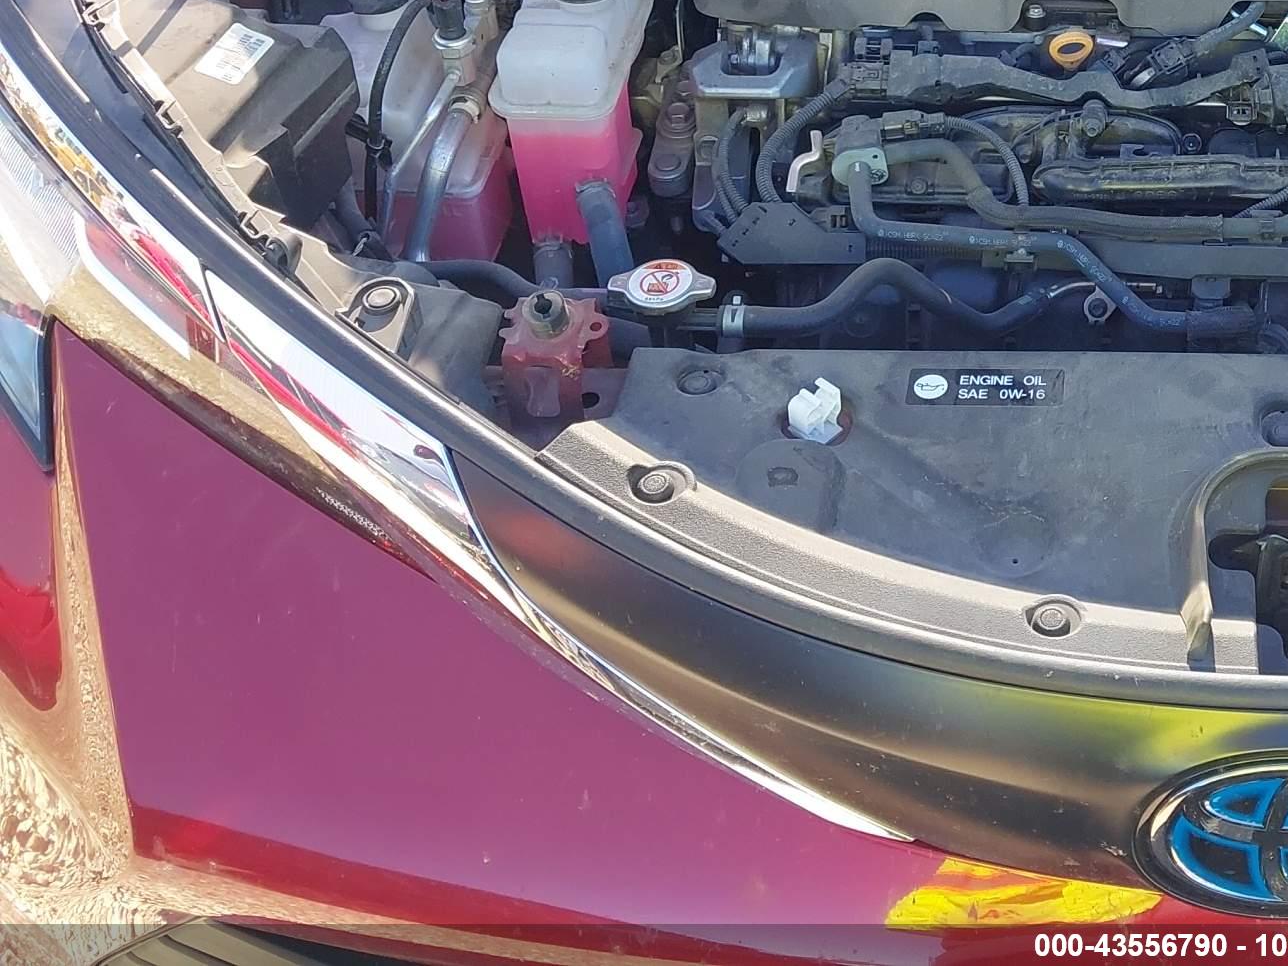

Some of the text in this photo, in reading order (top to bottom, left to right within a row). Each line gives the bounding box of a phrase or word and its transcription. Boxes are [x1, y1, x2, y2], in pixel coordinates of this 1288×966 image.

[959, 375, 1047, 386] ENGINE OIL
[958, 389, 1046, 400] SAE 0W-16
